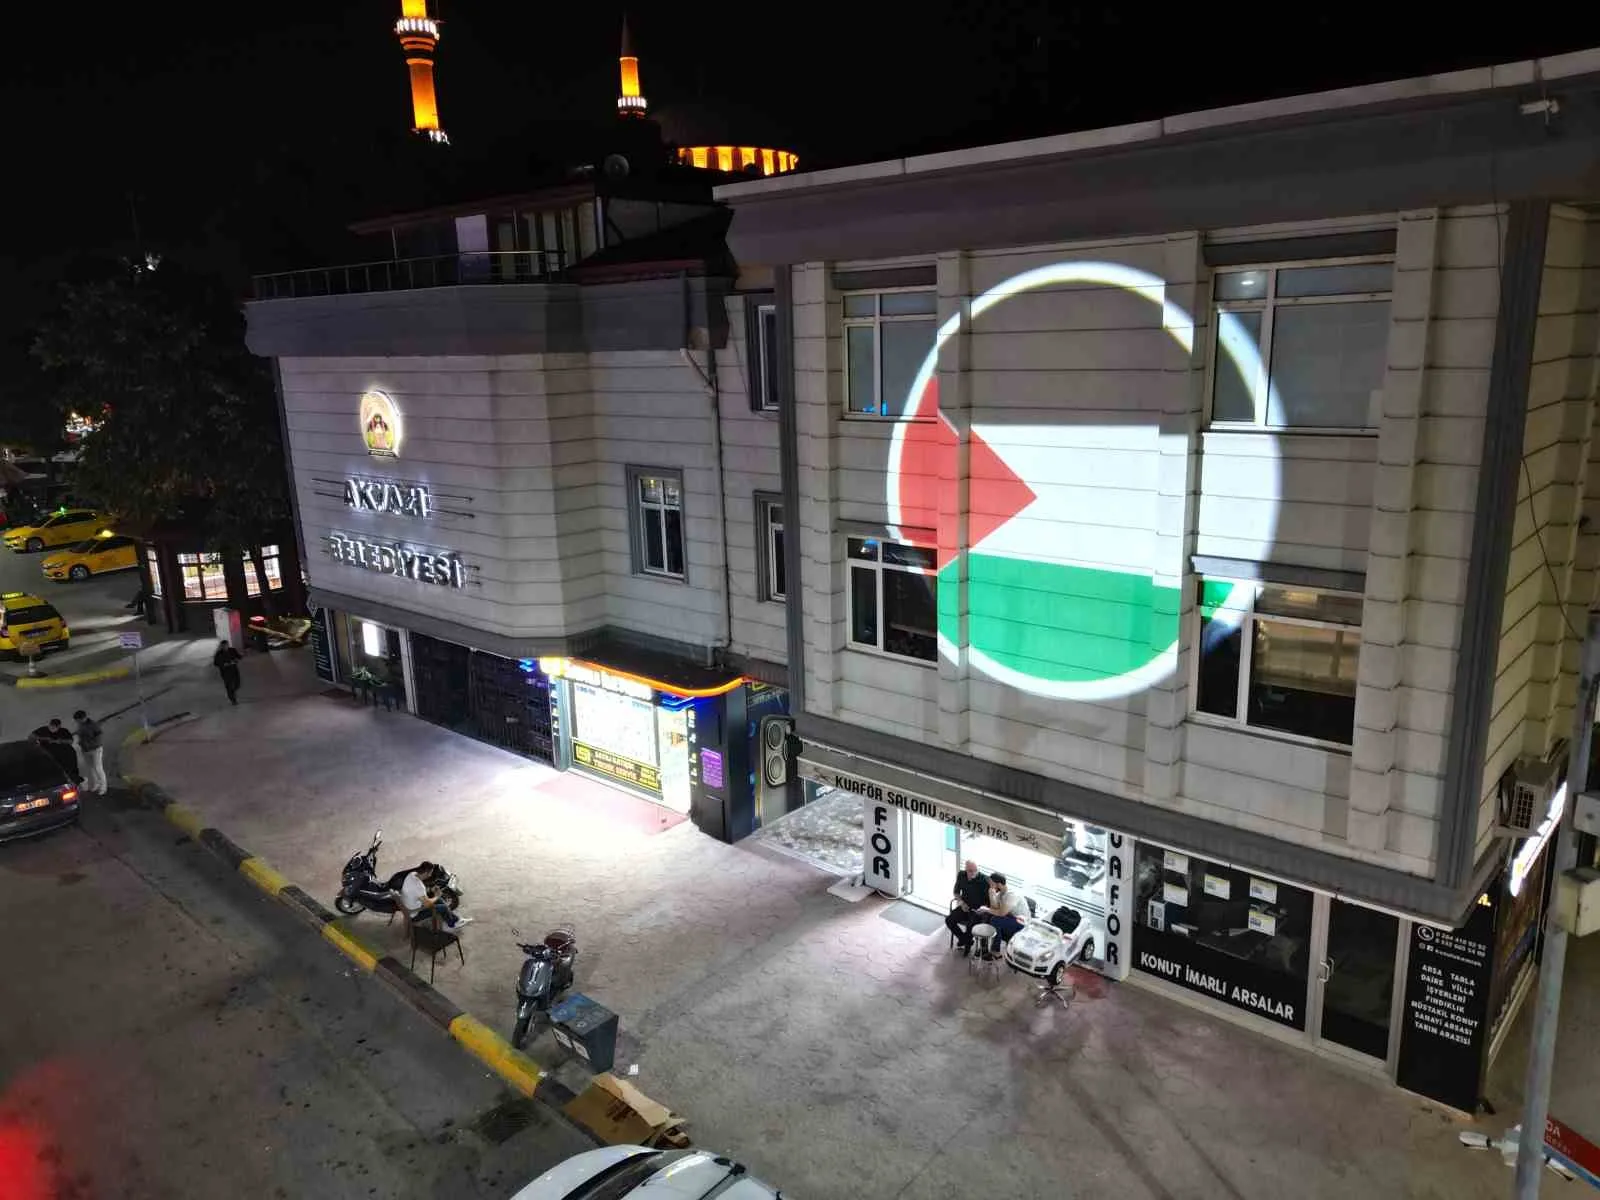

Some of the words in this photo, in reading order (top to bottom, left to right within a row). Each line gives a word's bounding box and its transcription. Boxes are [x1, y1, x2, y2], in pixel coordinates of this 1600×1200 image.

[887, 791, 937, 818] SALONU
[938, 811, 963, 826] 0544
[1140, 951, 1182, 978] KONUT
[1185, 964, 1227, 996] İMARLI
[1231, 986, 1294, 1021] ARSALAR
